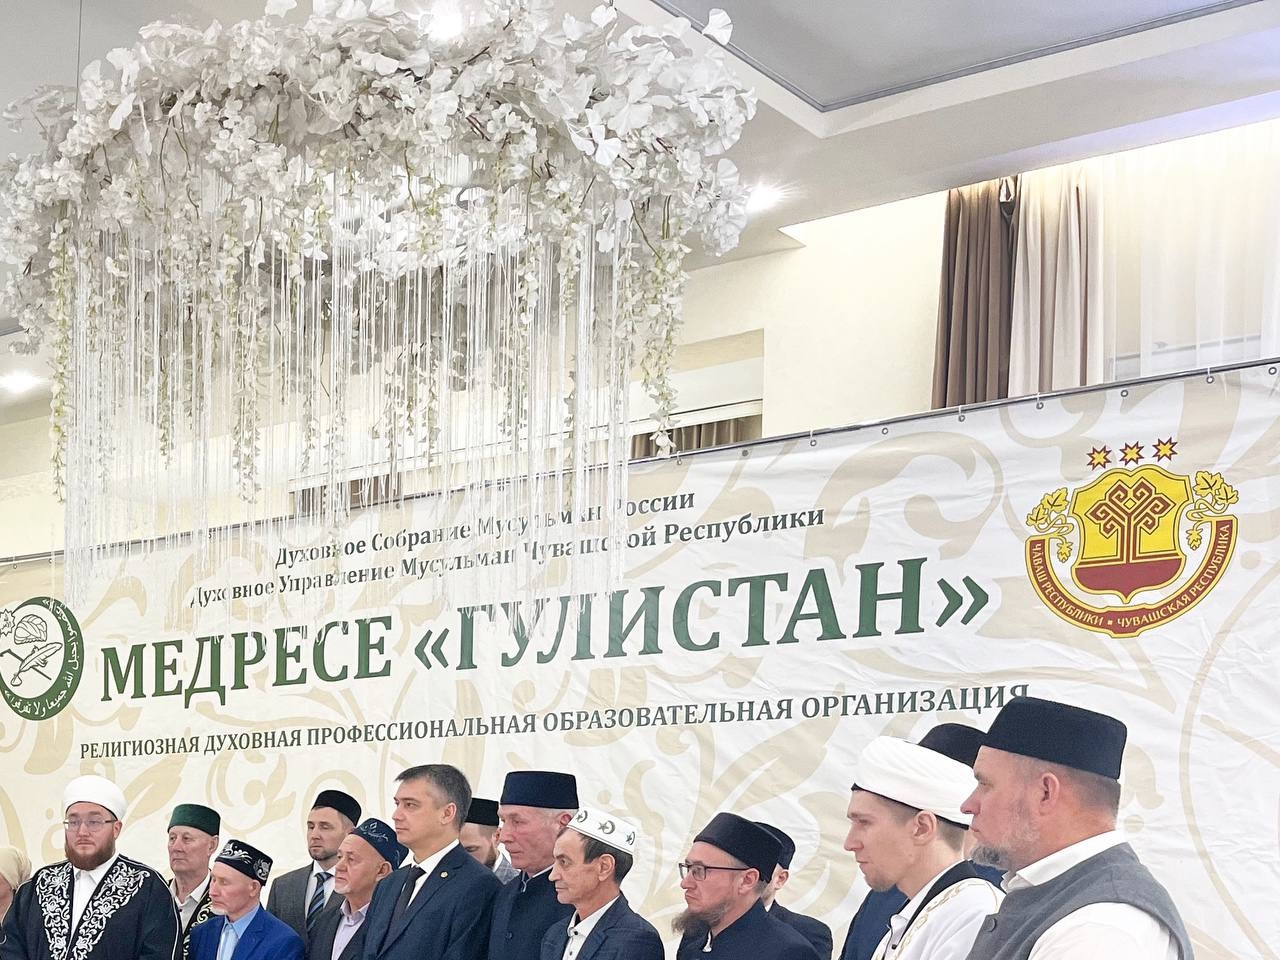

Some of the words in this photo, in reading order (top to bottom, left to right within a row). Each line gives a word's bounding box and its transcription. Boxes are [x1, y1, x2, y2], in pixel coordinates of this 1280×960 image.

[371, 523, 471, 552] Собрание
[478, 505, 602, 539] Мусуьмн
[616, 493, 695, 518] оссии
[524, 525, 656, 565] Чувашсой
[664, 508, 825, 544] Республики
[1041, 581, 1103, 626] РЕСПУБЛИКИ
[1117, 594, 1191, 628] ЧУВАШСКАЯ
[1189, 524, 1230, 597] РЕСПУБЛИКА
[100, 615, 393, 709] МЕДРЕСЕ
[413, 556, 990, 671] «ГУЛИСТАН»
[79, 736, 200, 760] РЕЛИГИОЗНАЯ
[203, 729, 302, 756] ДУХОВНАЯ
[306, 712, 537, 747] ПРОФЕССИОНАЛЬНАЯ
[543, 697, 793, 733] ОБРАЗОВАТЕЛЬНАЯ
[802, 684, 1029, 719] ОРГАНИЗАЦИЯ
